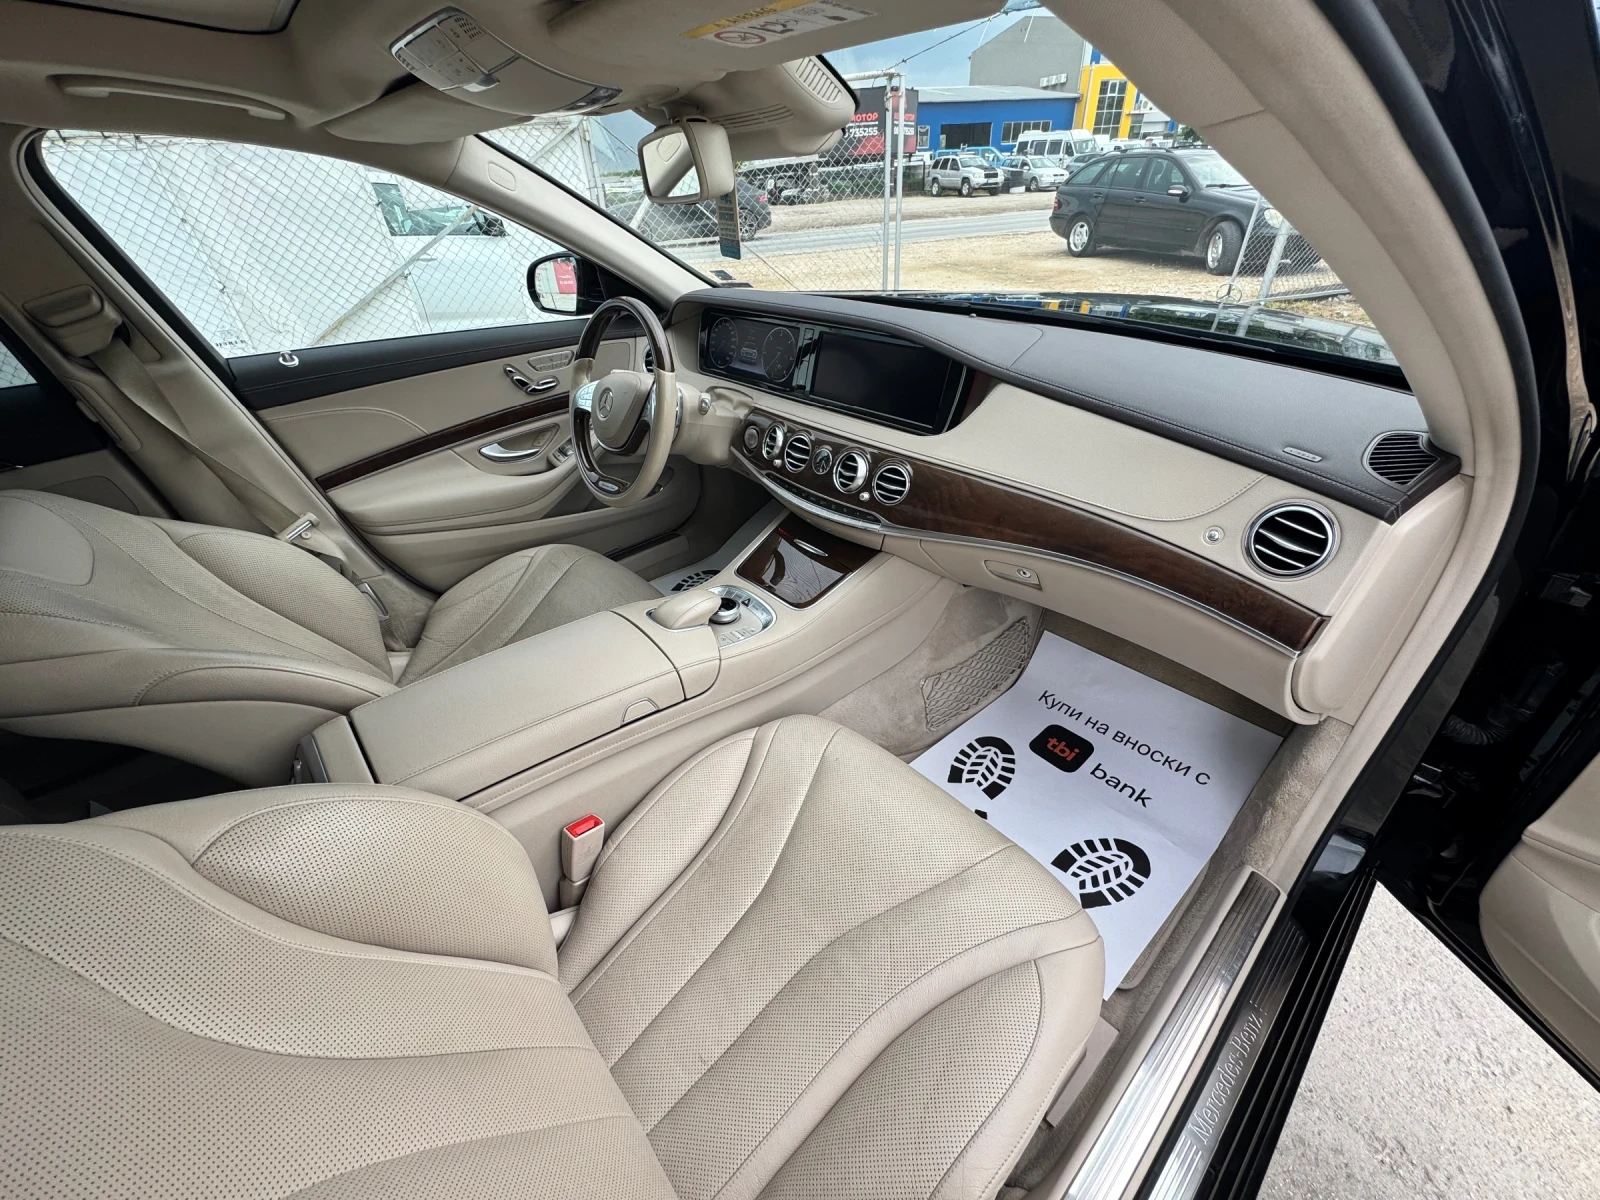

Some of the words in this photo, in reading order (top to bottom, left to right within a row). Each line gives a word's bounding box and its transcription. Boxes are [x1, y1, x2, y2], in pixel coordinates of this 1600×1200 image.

[849, 127, 879, 138] 735255
[1038, 690, 1083, 721] Купи
[1084, 716, 1110, 736] на
[1112, 730, 1192, 777] вноски
[1195, 772, 1211, 785] с
[1046, 737, 1080, 761] tbi
[1089, 763, 1153, 808] bank
[1188, 1013, 1264, 1146] Mercedes-Benz
